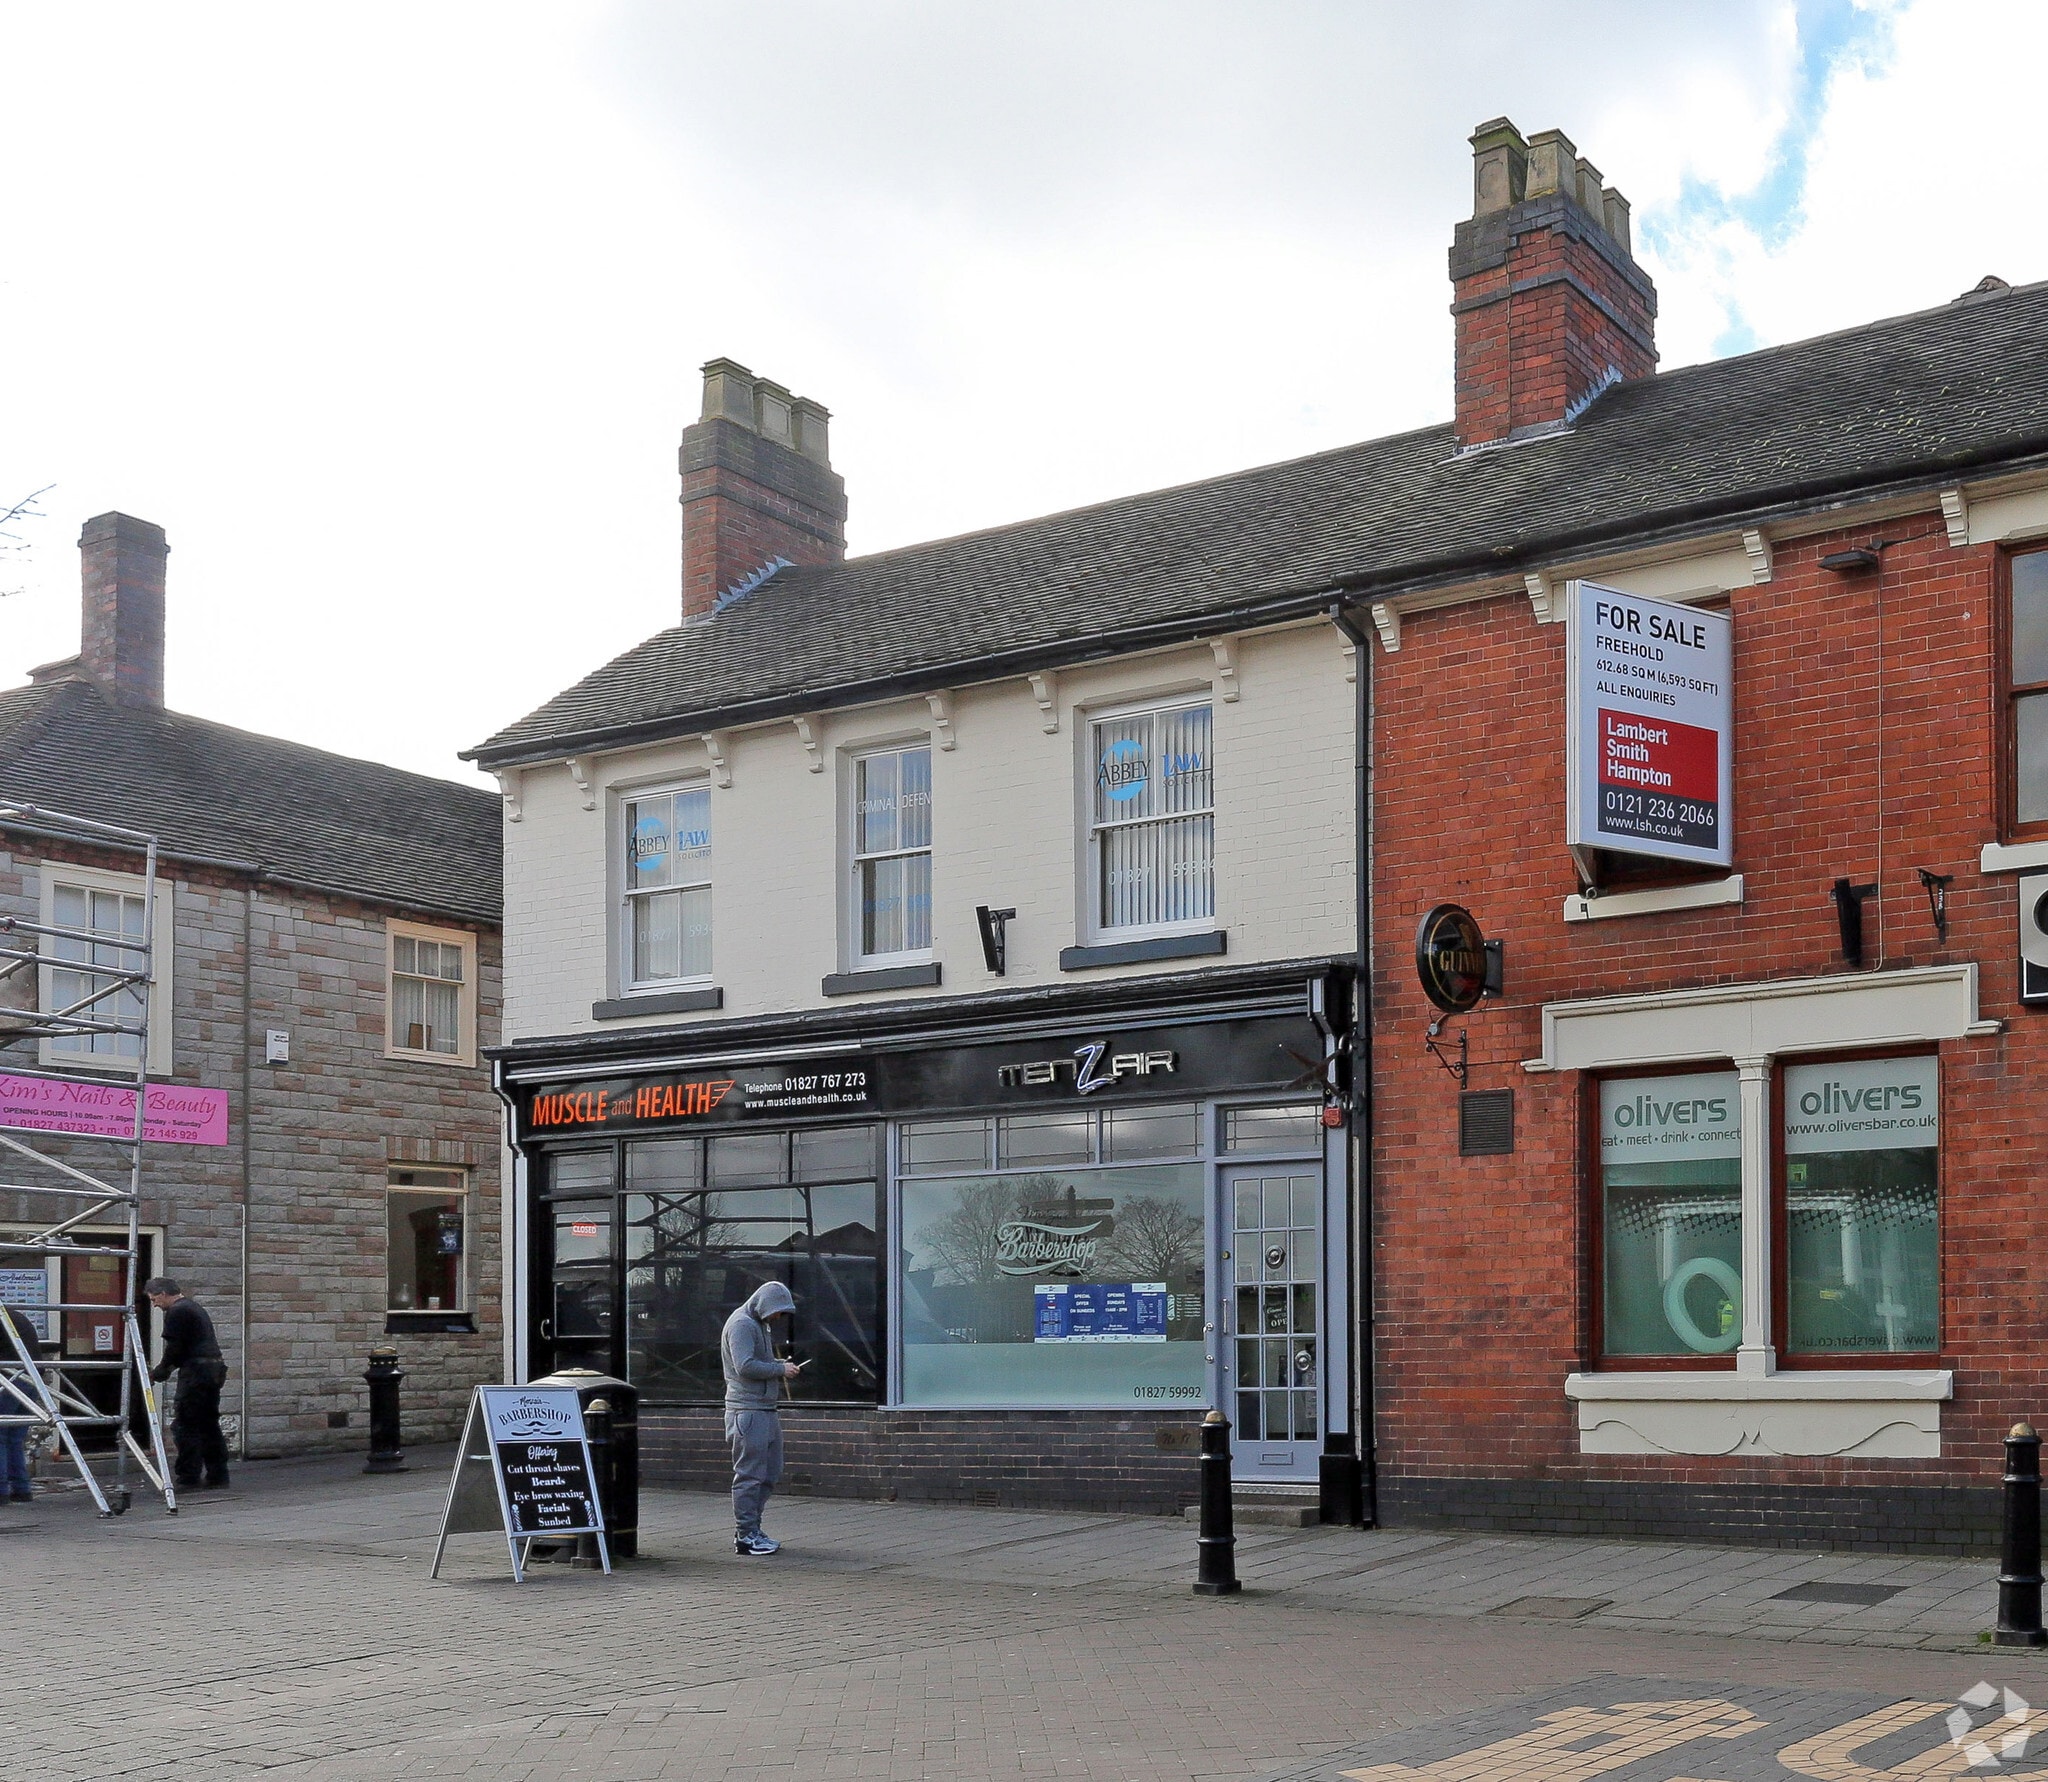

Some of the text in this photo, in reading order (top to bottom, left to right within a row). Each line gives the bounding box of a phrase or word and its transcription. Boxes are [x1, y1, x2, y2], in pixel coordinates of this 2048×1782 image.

[1596, 601, 1706, 650] FOR SALE
[1596, 635, 1664, 662] FREEHOLD
[1596, 659, 1629, 675] 612.68
[1658, 672, 1686, 689] (6,593
[1596, 680, 1676, 706] ALL ENQUIRIES
[1606, 717, 1668, 746] Lambert
[1606, 738, 1650, 763] Smith
[1096, 751, 1203, 787] ABBEY LAW
[1606, 758, 1672, 787] Hampton
[857, 797, 896, 815] CRIMINAL
[1606, 791, 1714, 826] 0121 236 2066
[1605, 816, 1684, 837] www.lsh.co.uk
[627, 829, 709, 859] ABBEY LAW
[744, 1072, 867, 1094] Telephone 01827 767 273
[59, 1083, 114, 1106] Nails
[147, 1091, 218, 1124] Beauty
[532, 1082, 711, 1127] MUSCLE and HEALTH
[744, 1090, 867, 1109] www.muscleandhealth.co.uk
[1800, 1082, 1923, 1116] olivers
[3, 1106, 39, 1116] OPENING
[41, 1109, 68, 1118] HOURS
[143, 1117, 166, 1126] onday
[1614, 1095, 1728, 1128] olivers
[57, 1120, 96, 1133] 437323
[160, 1129, 177, 1139] 145
[180, 1131, 198, 1140] 929
[1786, 1114, 1937, 1135] www.oliversbar.co.uk
[1626, 1133, 1652, 1145] meet
[1661, 1130, 1689, 1143] drink
[1698, 1127, 1741, 1141] connect
[572, 1225, 597, 1234] CLOSED
[997, 1226, 1097, 1268] Barbershop
[1133, 1386, 1202, 1399] 01827 59992
[498, 1407, 571, 1426] BARBERSHOP
[527, 1445, 557, 1461] Offering
[507, 1462, 580, 1474] Cut throat shaves
[531, 1476, 566, 1487] Beards
[514, 1489, 584, 1504] Eye brow waxing
[537, 1503, 571, 1513] Facials
[538, 1516, 572, 1527] Sunbed
